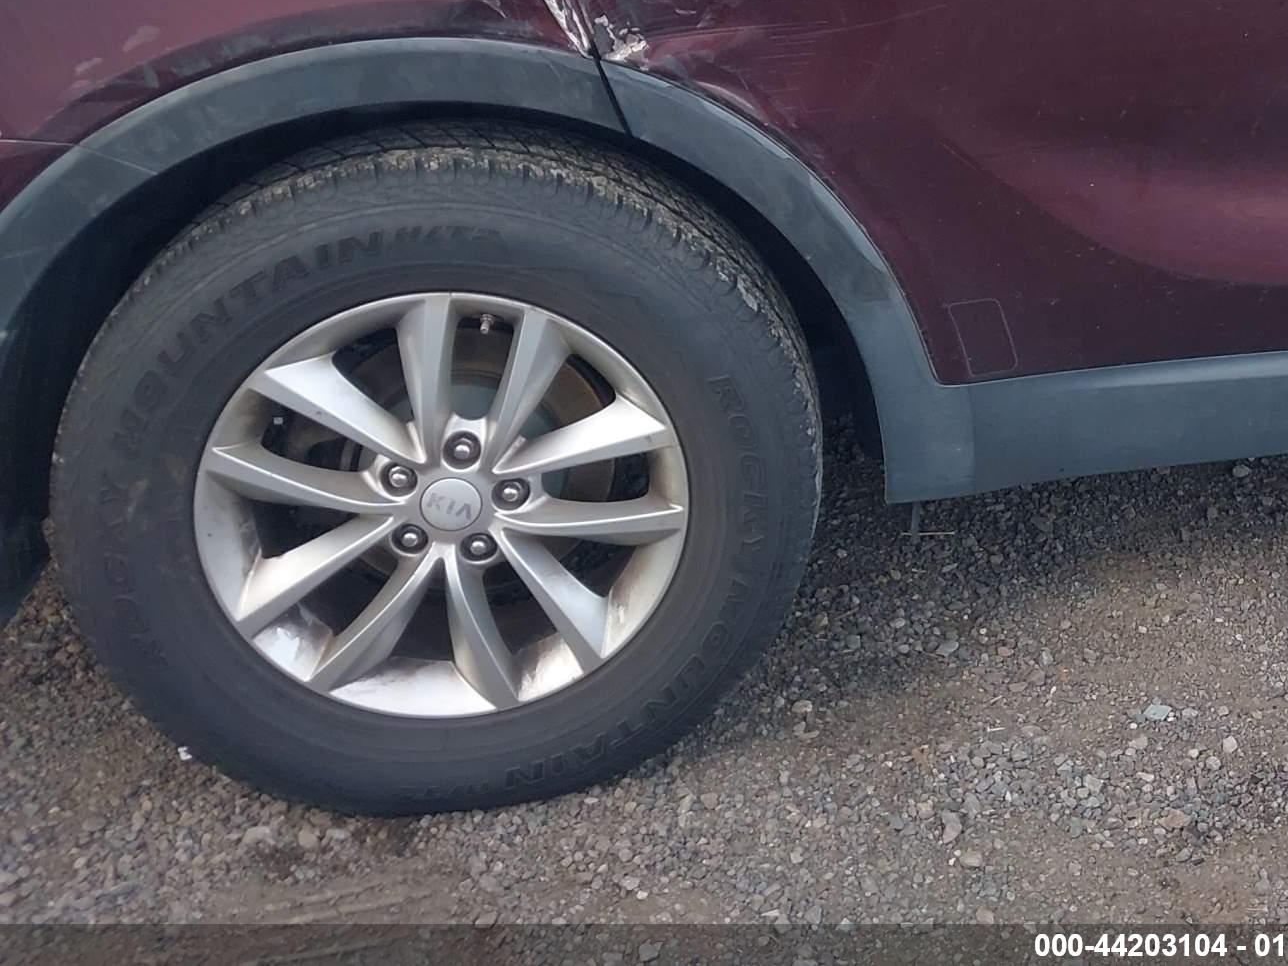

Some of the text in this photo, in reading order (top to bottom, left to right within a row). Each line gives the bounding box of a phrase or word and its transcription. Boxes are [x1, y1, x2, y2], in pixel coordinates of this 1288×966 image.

[111, 230, 385, 452] MOUNTAIN
[426, 492, 473, 522] KIA
[506, 373, 770, 791] ROCKY MOUNTAIN
